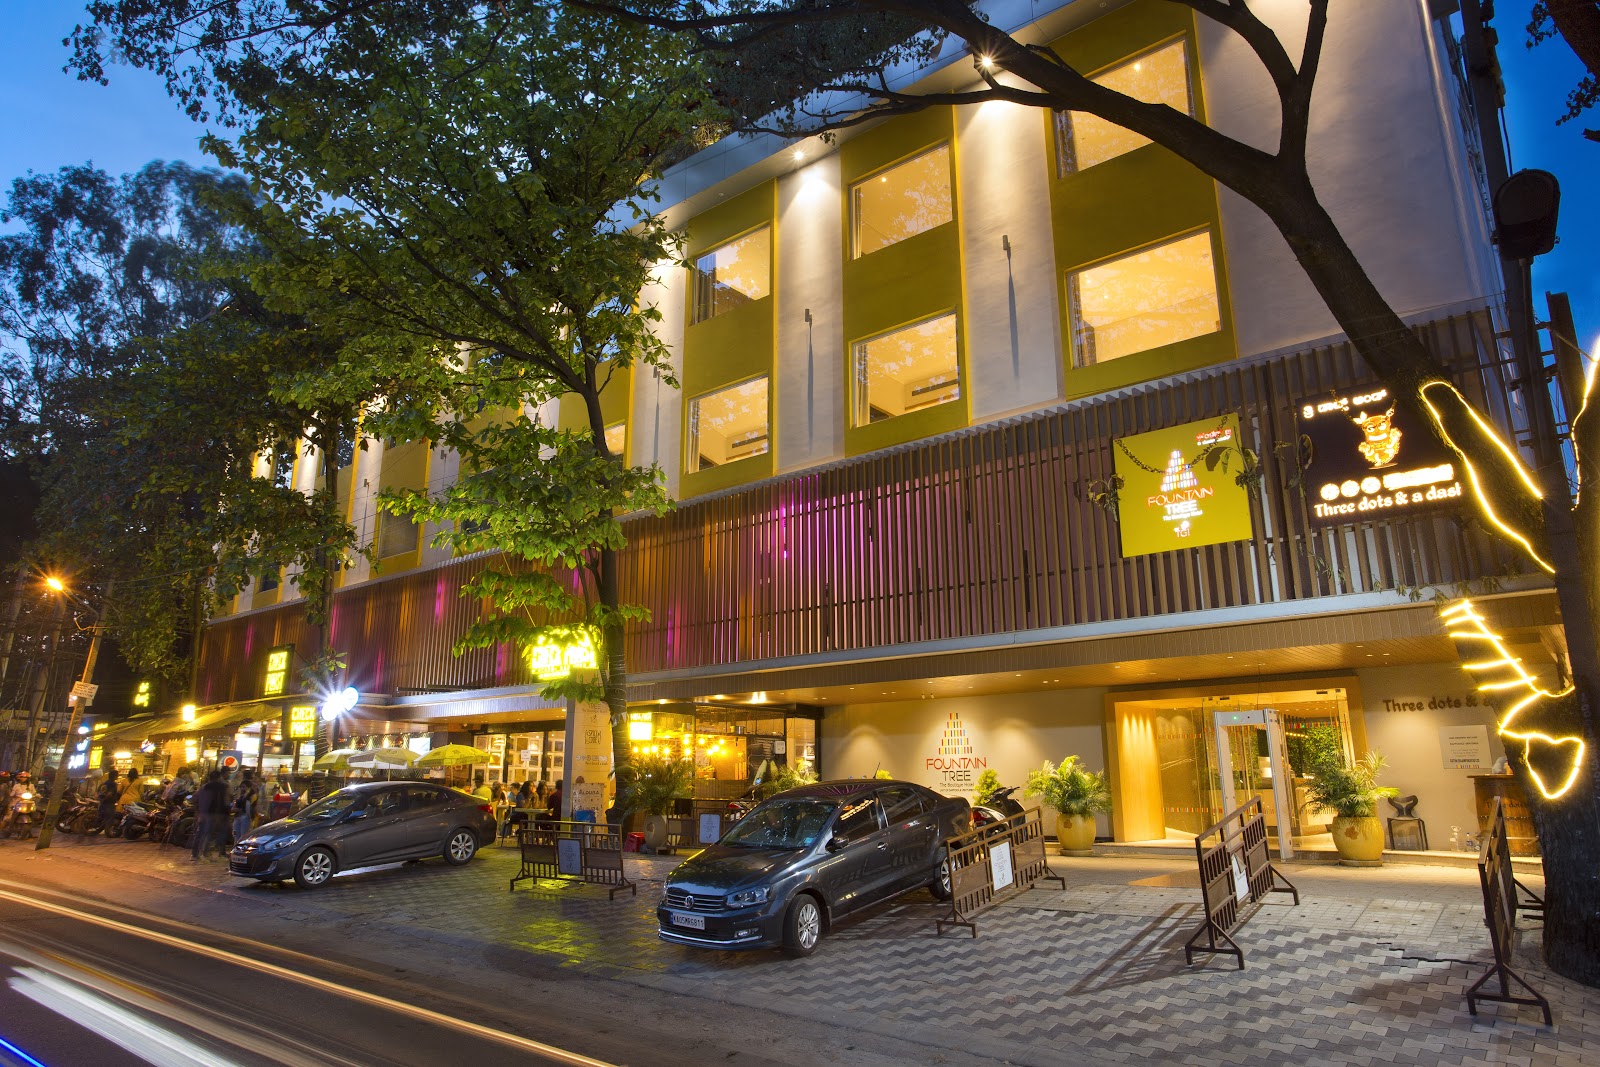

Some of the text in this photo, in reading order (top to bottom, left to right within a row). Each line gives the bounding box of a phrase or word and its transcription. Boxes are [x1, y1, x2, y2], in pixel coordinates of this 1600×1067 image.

[1147, 486, 1214, 508] FOUNTAIN
[1314, 502, 1355, 518] Three
[1358, 495, 1393, 511] dots
[1395, 491, 1408, 505] &
[1411, 492, 1423, 503] a
[1163, 499, 1198, 515] TREE
[1383, 699, 1424, 712] Three
[1428, 697, 1461, 710] dots
[1466, 695, 1477, 707] &
[291, 707, 315, 721] CHECK
[290, 721, 315, 737] POST
[926, 757, 987, 770] FOUNTAIN
[942, 770, 971, 781] TREE
